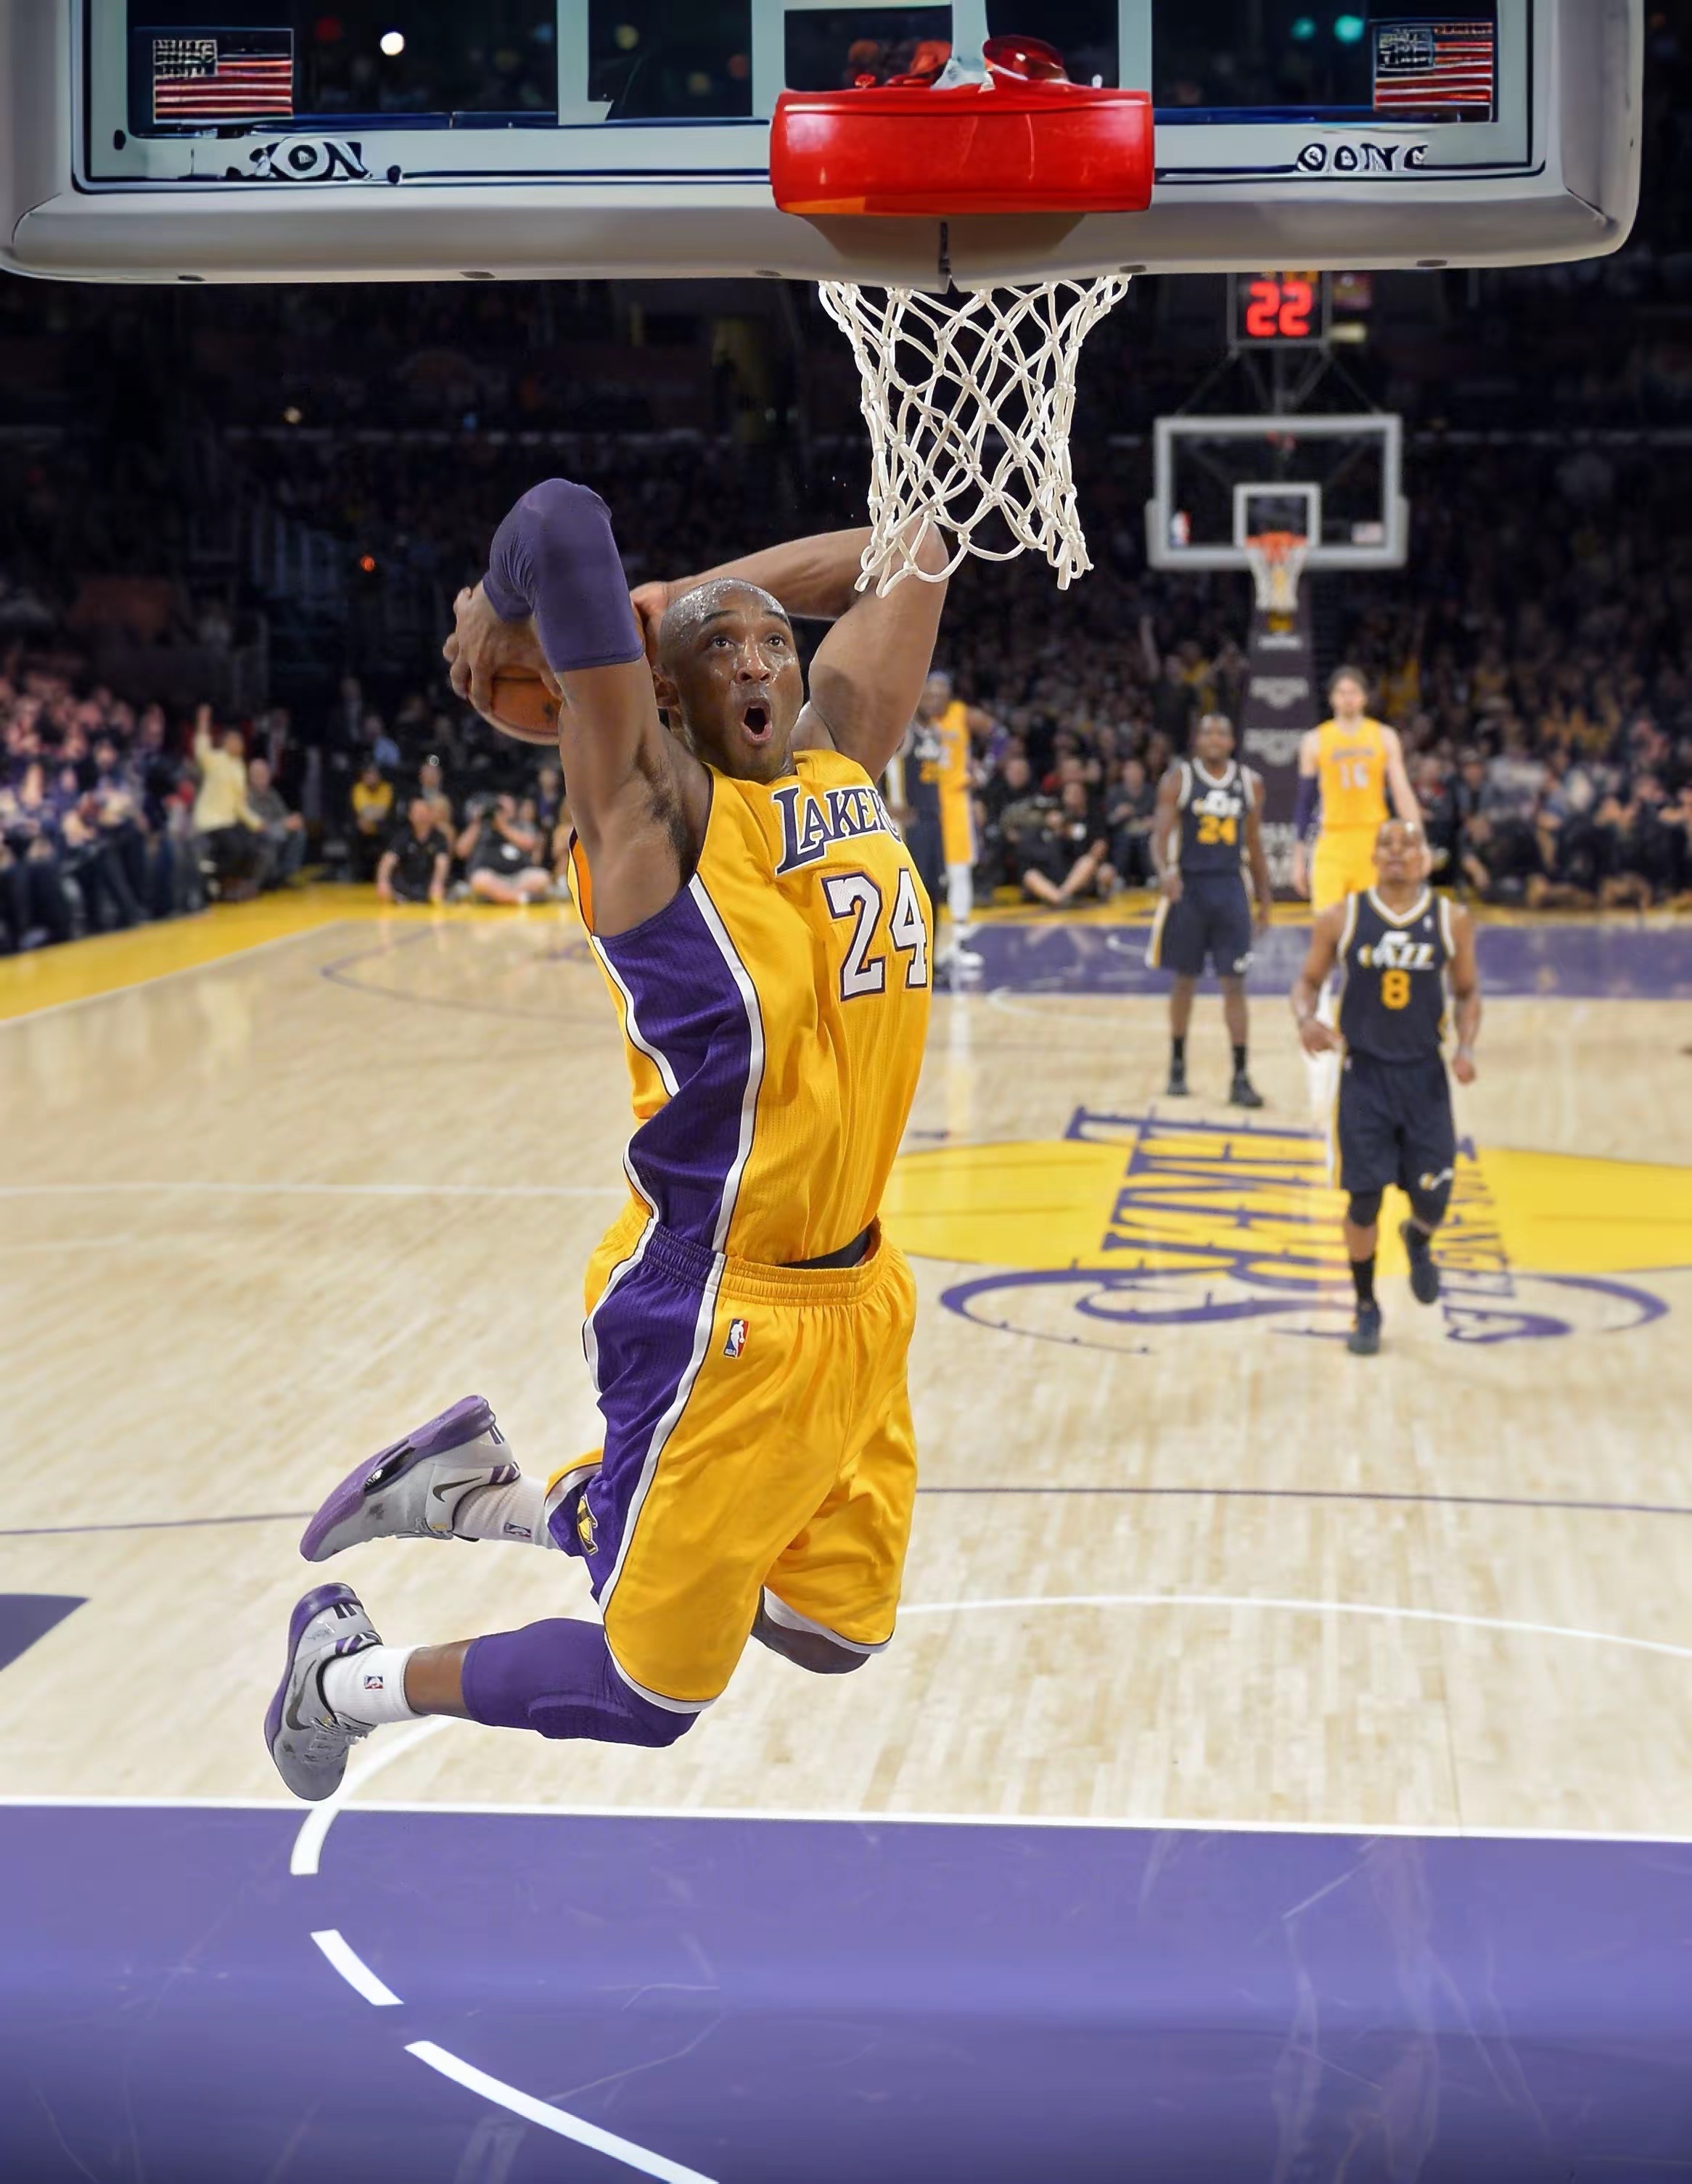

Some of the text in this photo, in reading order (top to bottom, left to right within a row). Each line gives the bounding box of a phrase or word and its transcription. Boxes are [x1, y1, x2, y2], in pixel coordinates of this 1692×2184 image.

[1246, 281, 1313, 337] 22
[1197, 815, 1237, 847] 24
[821, 868, 927, 1001] 24
[1381, 969, 1411, 1009] 8
